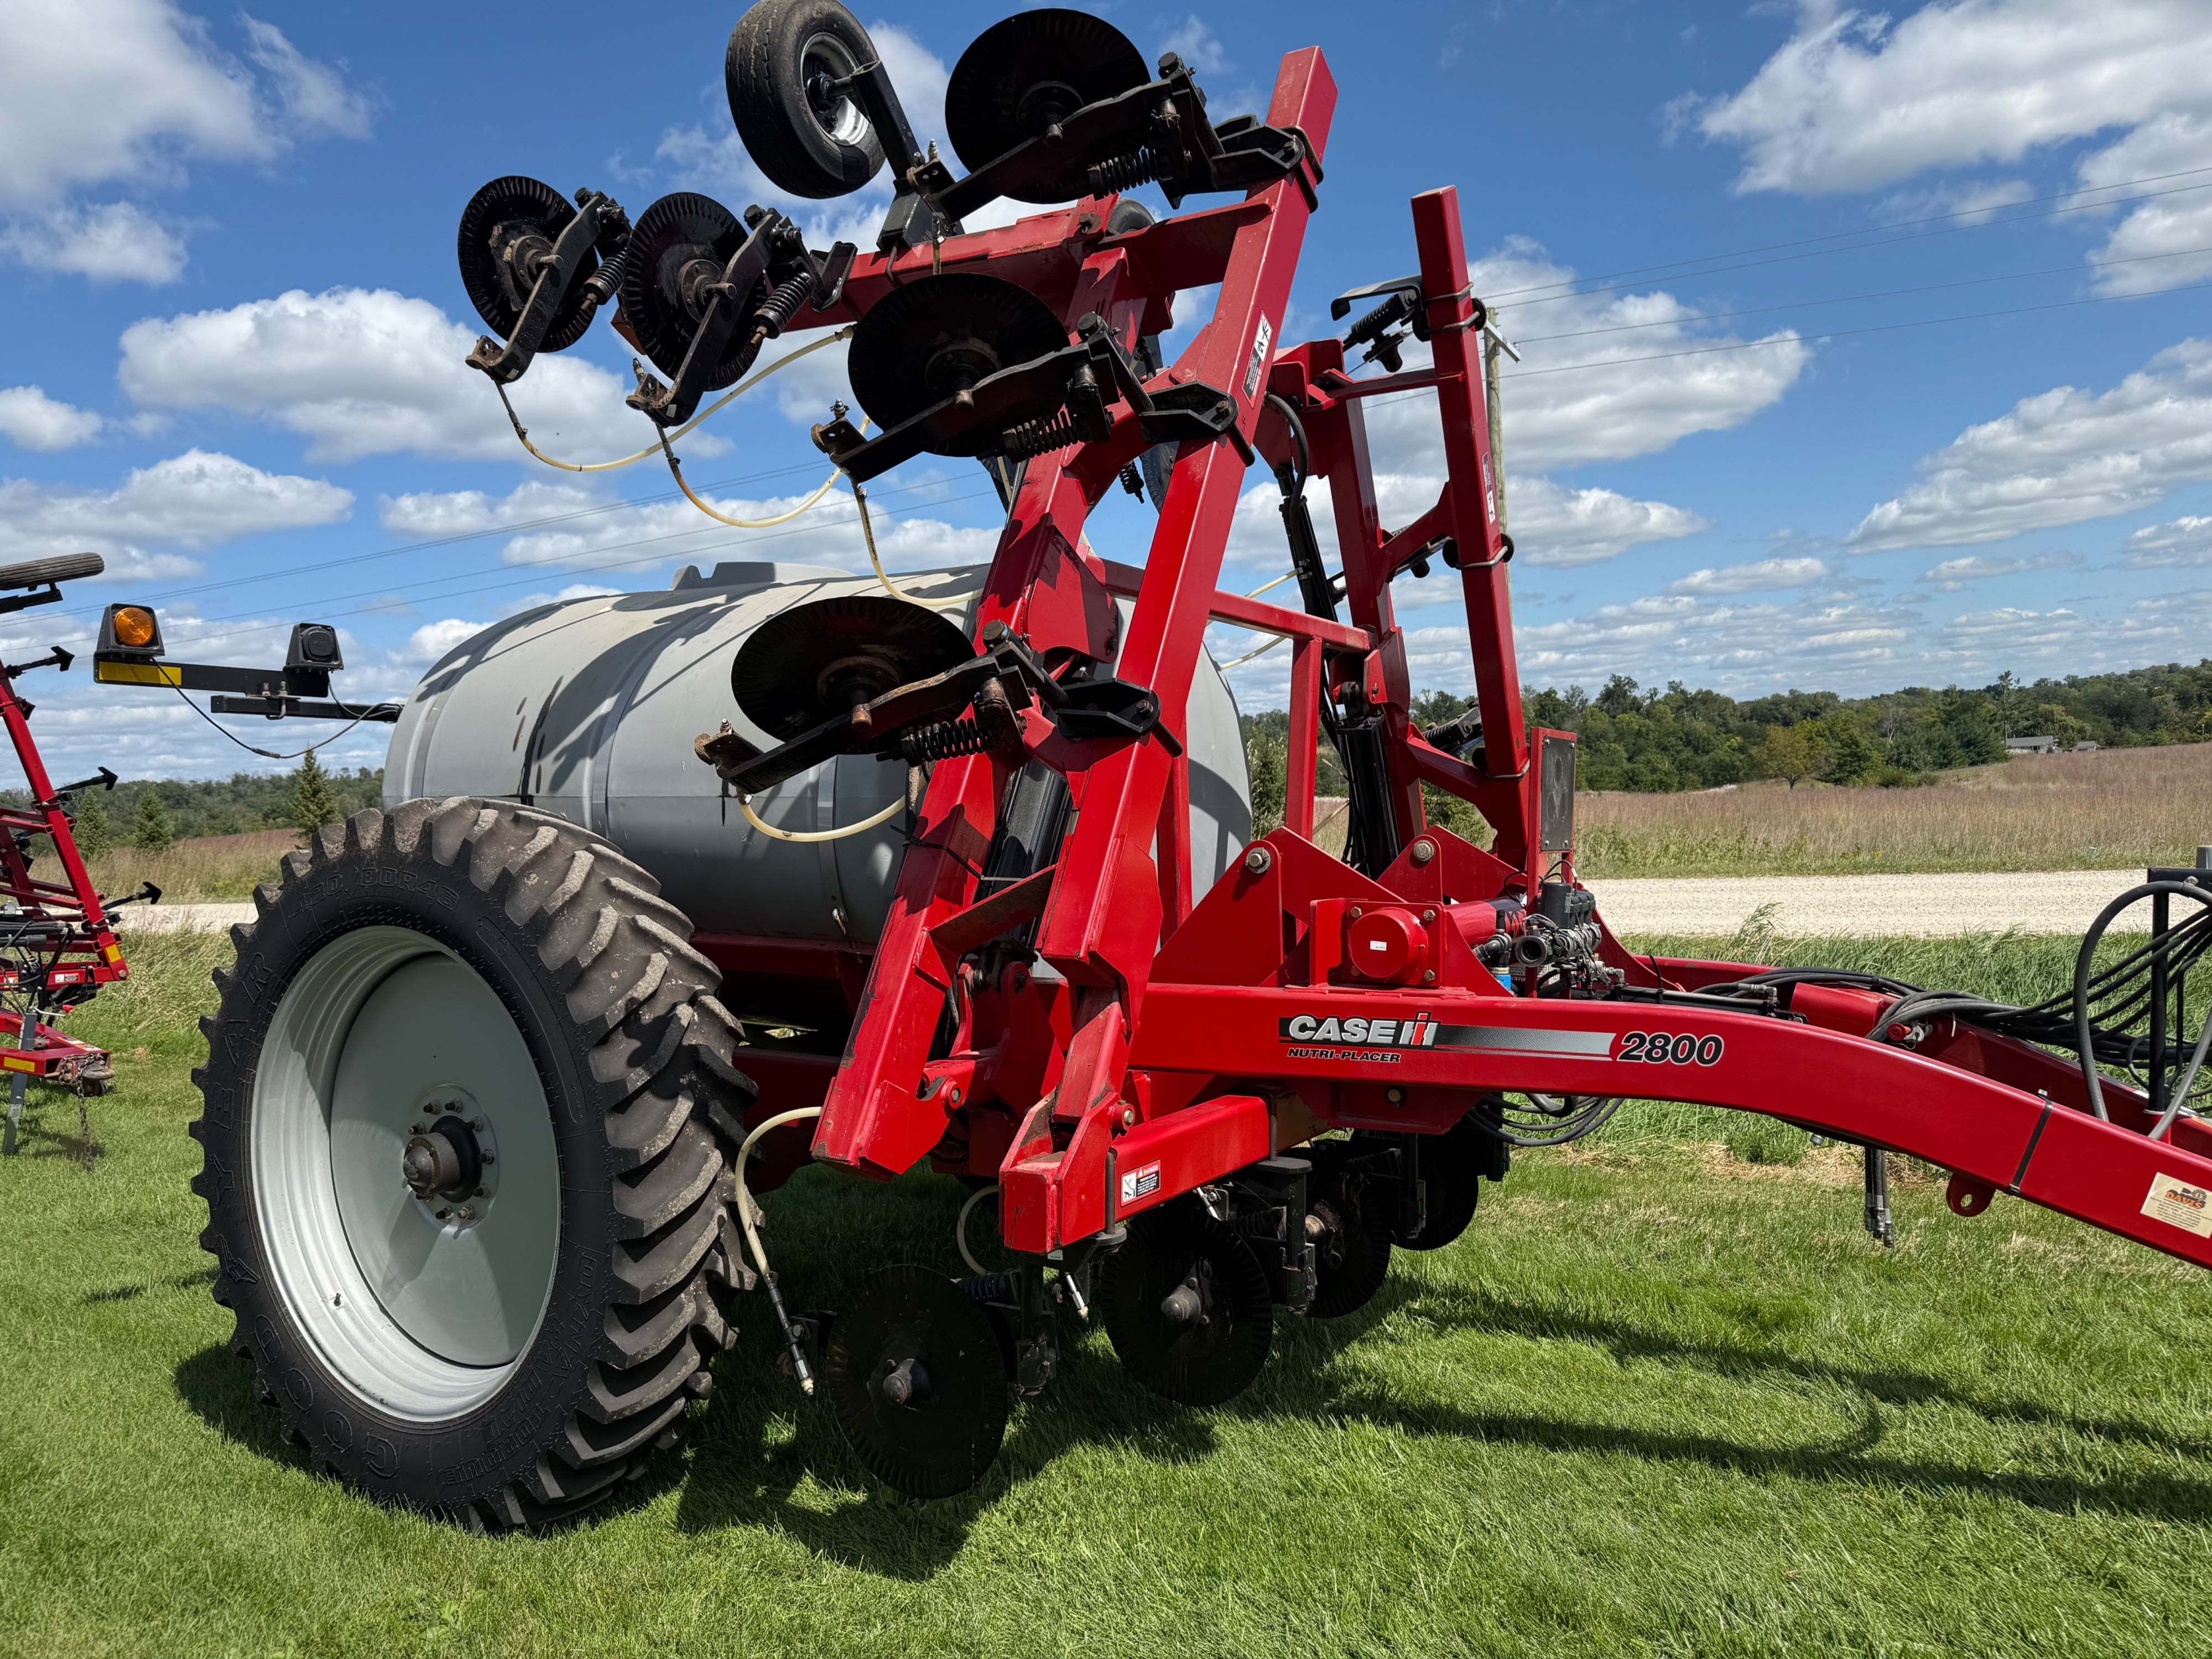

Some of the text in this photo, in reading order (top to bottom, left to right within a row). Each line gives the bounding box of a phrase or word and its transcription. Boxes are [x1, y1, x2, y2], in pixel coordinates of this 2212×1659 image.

[1288, 1014, 1398, 1045] CASE
[1287, 1047, 1401, 1063] NUTRI-PLACER
[1616, 1030, 1724, 1067] 2800
[2166, 1189, 2206, 1209] DAVIS
[439, 1402, 551, 1485] TORQUE
